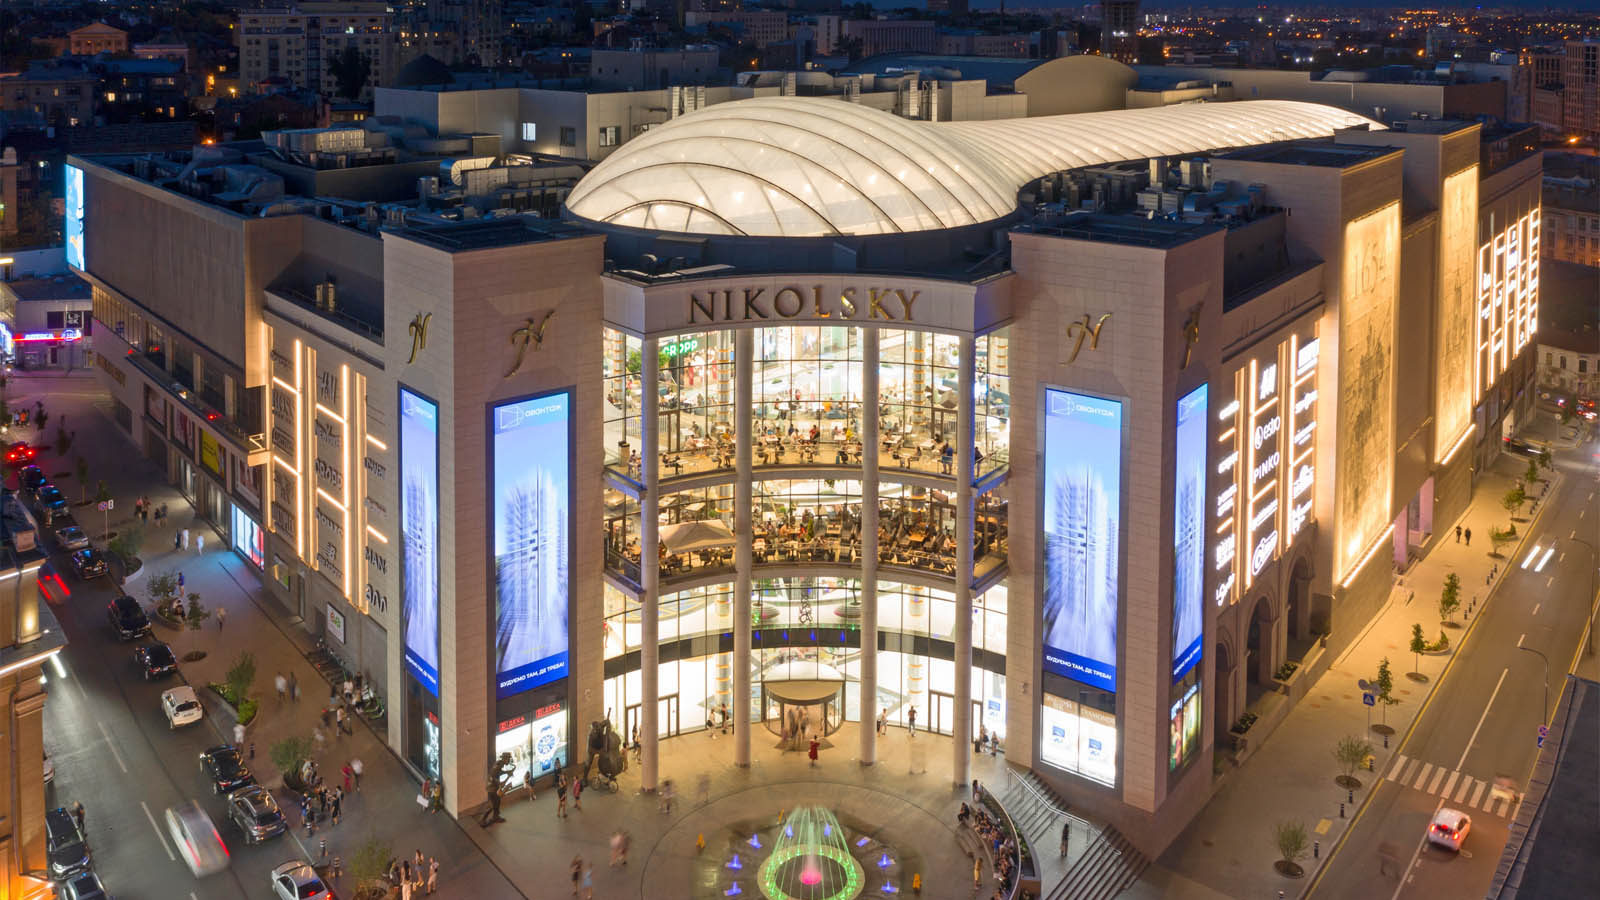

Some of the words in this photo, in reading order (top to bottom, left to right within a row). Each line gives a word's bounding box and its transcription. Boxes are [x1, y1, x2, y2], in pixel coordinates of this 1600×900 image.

[690, 285, 921, 324] NIKOLSKY
[663, 340, 698, 357] CROPP
[1254, 452, 1280, 484] PINKO
